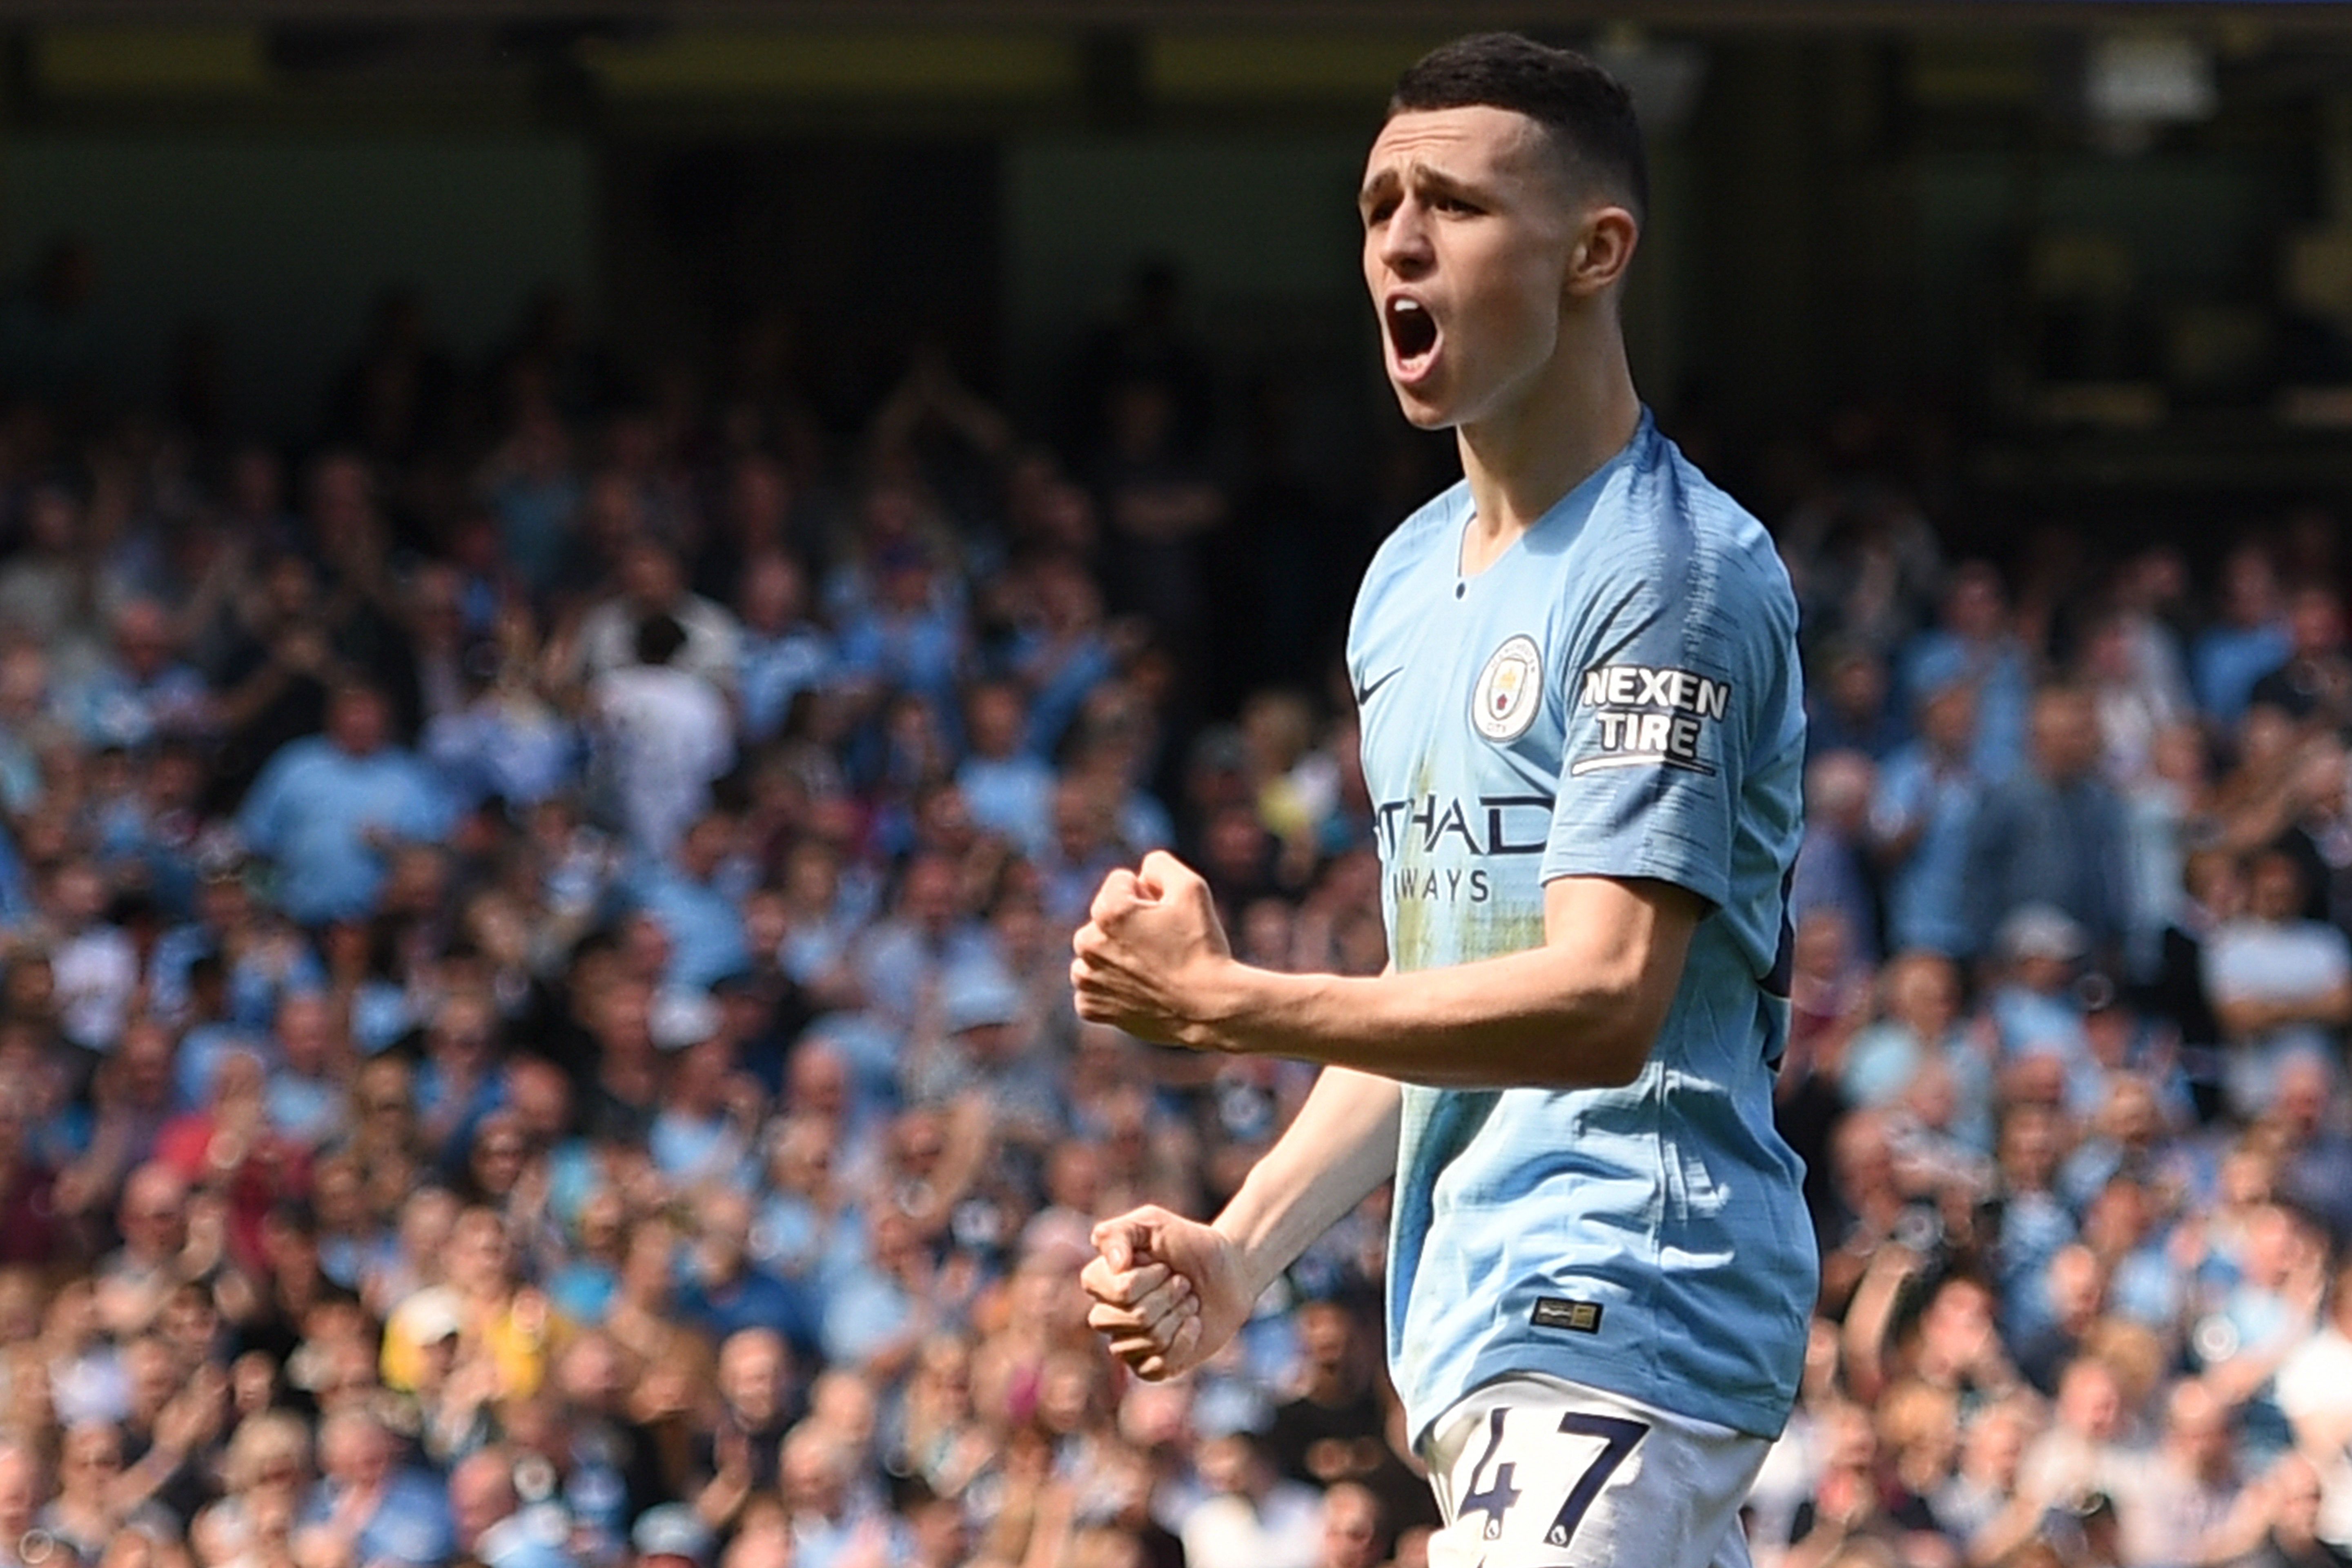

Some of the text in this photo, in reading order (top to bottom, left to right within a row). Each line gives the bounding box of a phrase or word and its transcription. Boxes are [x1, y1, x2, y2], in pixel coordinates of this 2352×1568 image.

[1583, 666, 1728, 720] NEXEN
[1597, 712, 1698, 757] TIRE
[1457, 1407, 1650, 1547] 47
